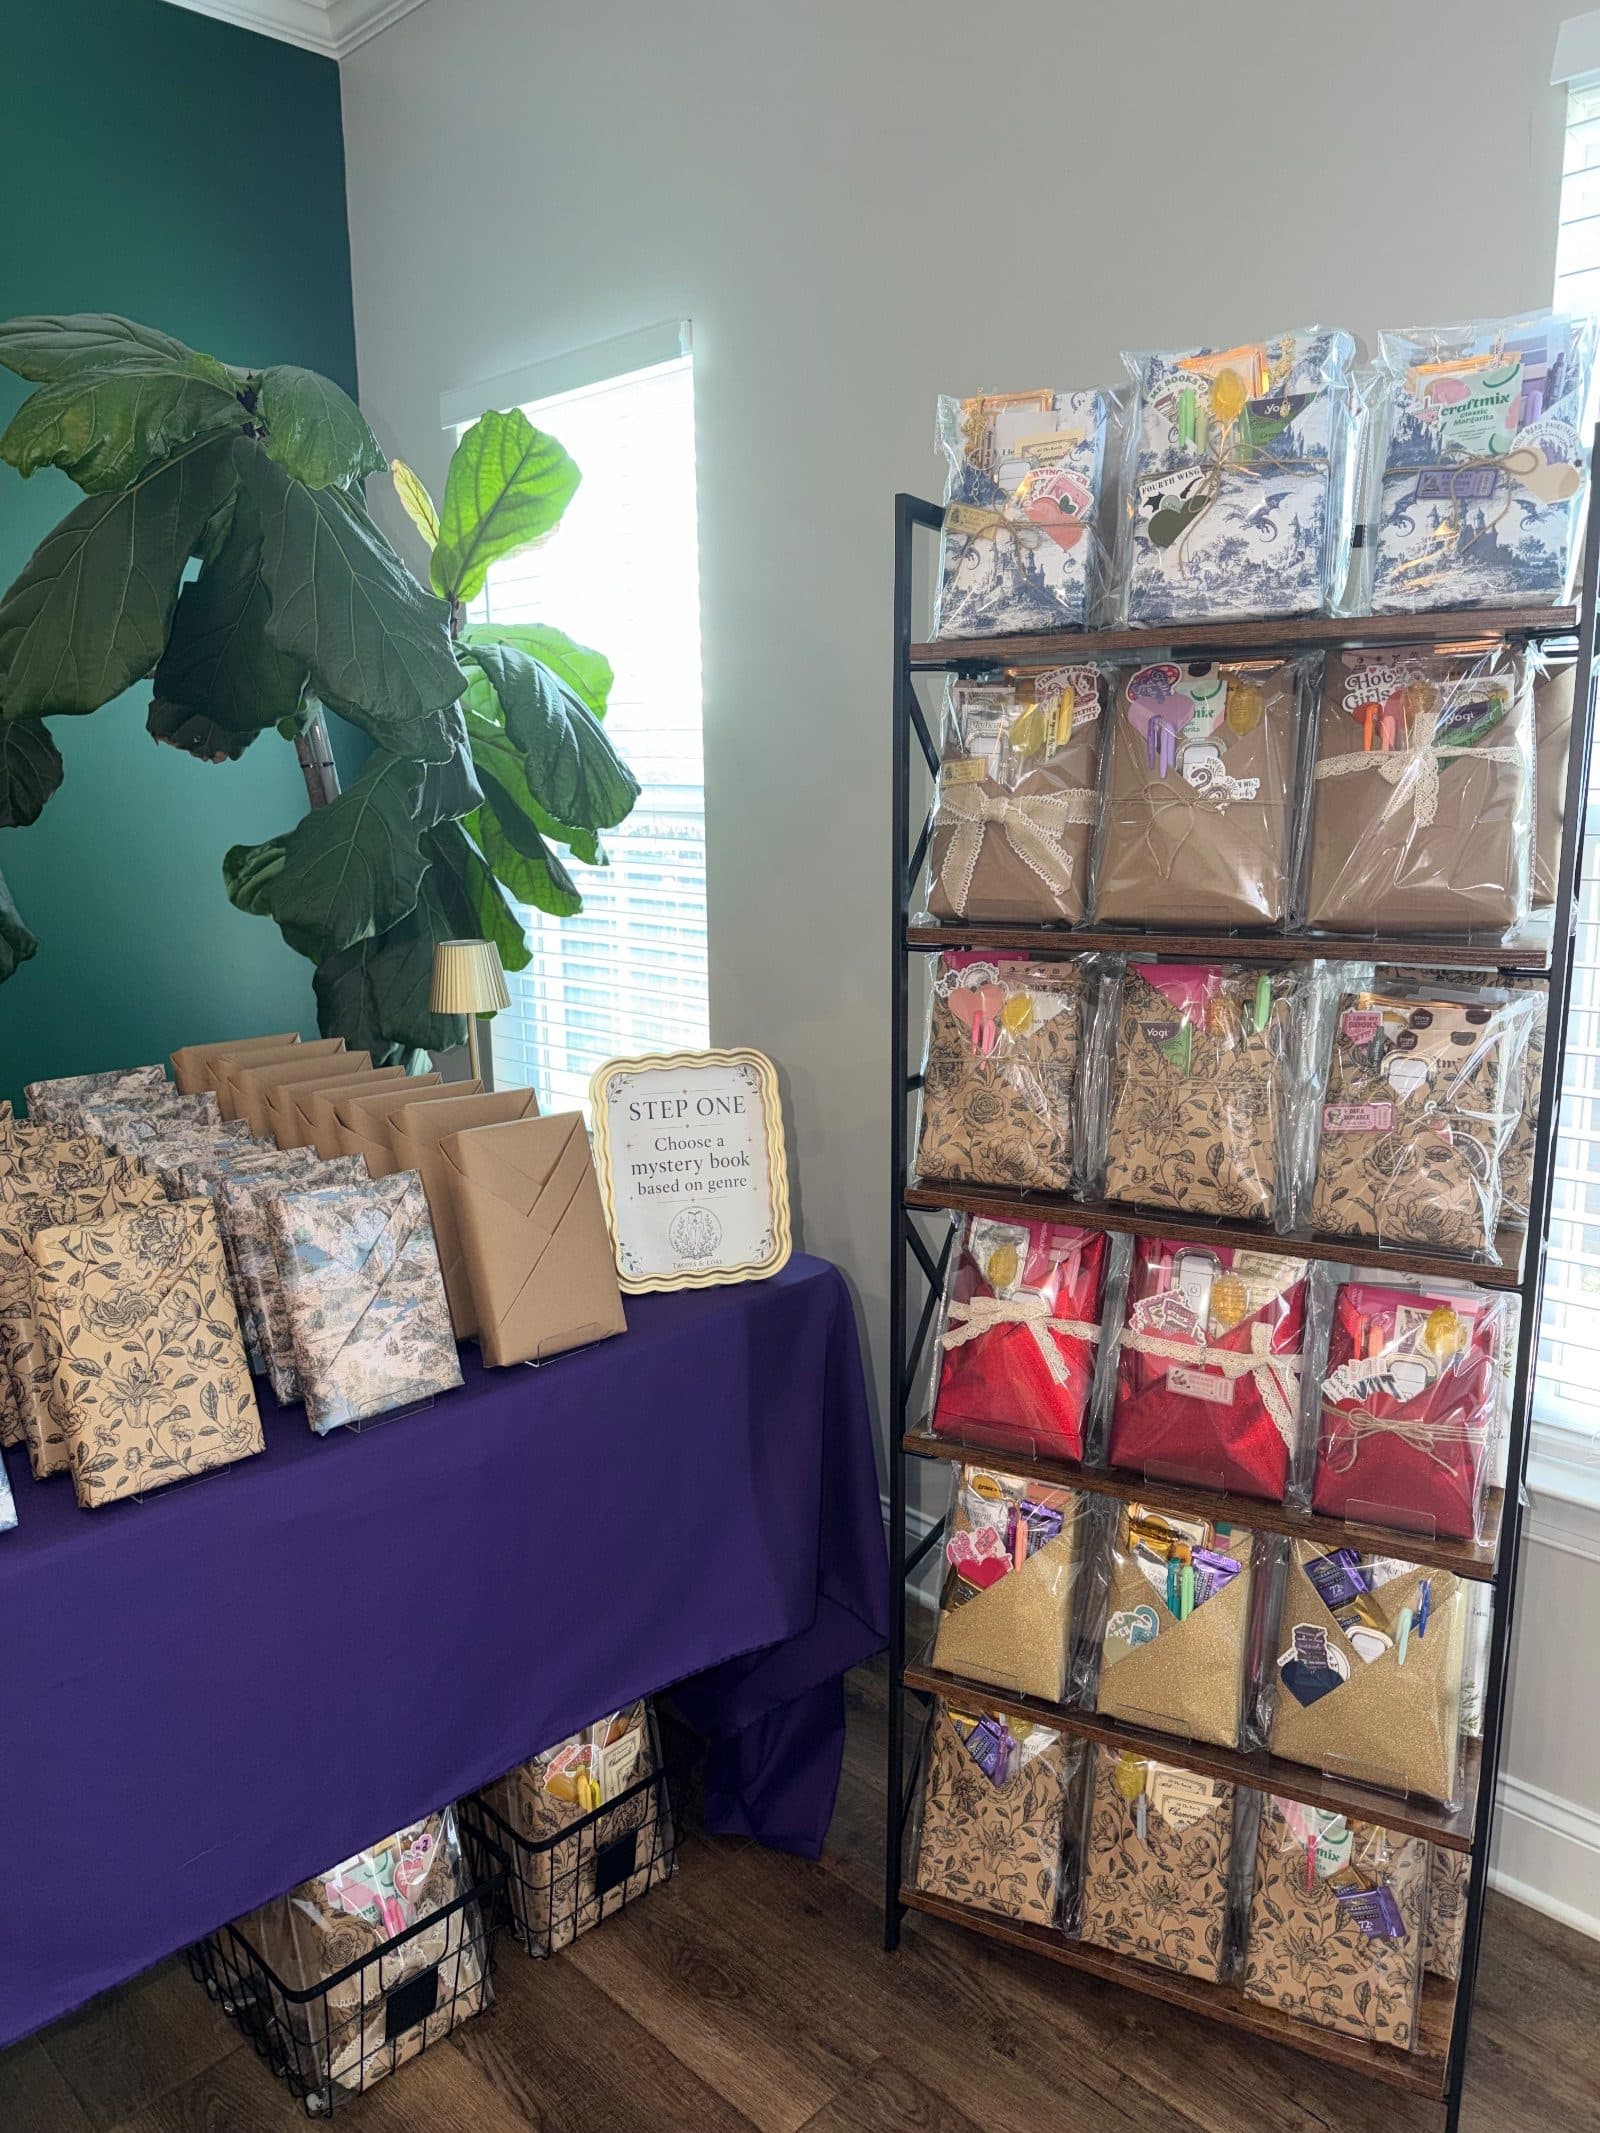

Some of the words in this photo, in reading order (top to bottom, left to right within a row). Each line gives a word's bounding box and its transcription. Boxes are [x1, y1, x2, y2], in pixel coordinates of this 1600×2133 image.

[1164, 374, 1198, 387] BOOKS
[1441, 392, 1510, 416] craftmix
[1459, 408, 1488, 418] Classic
[1453, 414, 1494, 426] Margarita
[1032, 469, 1062, 478] RYING
[1141, 477, 1176, 495] FOURTH
[1176, 468, 1202, 482] WING
[1041, 671, 1058, 684] LIKE
[1072, 666, 1099, 677] BOOKS
[1346, 670, 1393, 690] Hot
[1344, 687, 1391, 710] Girls
[629, 1099, 689, 1122] STEP
[696, 1095, 747, 1117] ONE
[654, 1136, 712, 1152] Choose
[716, 1137, 725, 1148] a
[631, 1156, 703, 1179] mystery
[710, 1150, 751, 1169] book
[637, 1179, 680, 1196] based
[685, 1180, 703, 1192] on
[708, 1177, 748, 1193] genre
